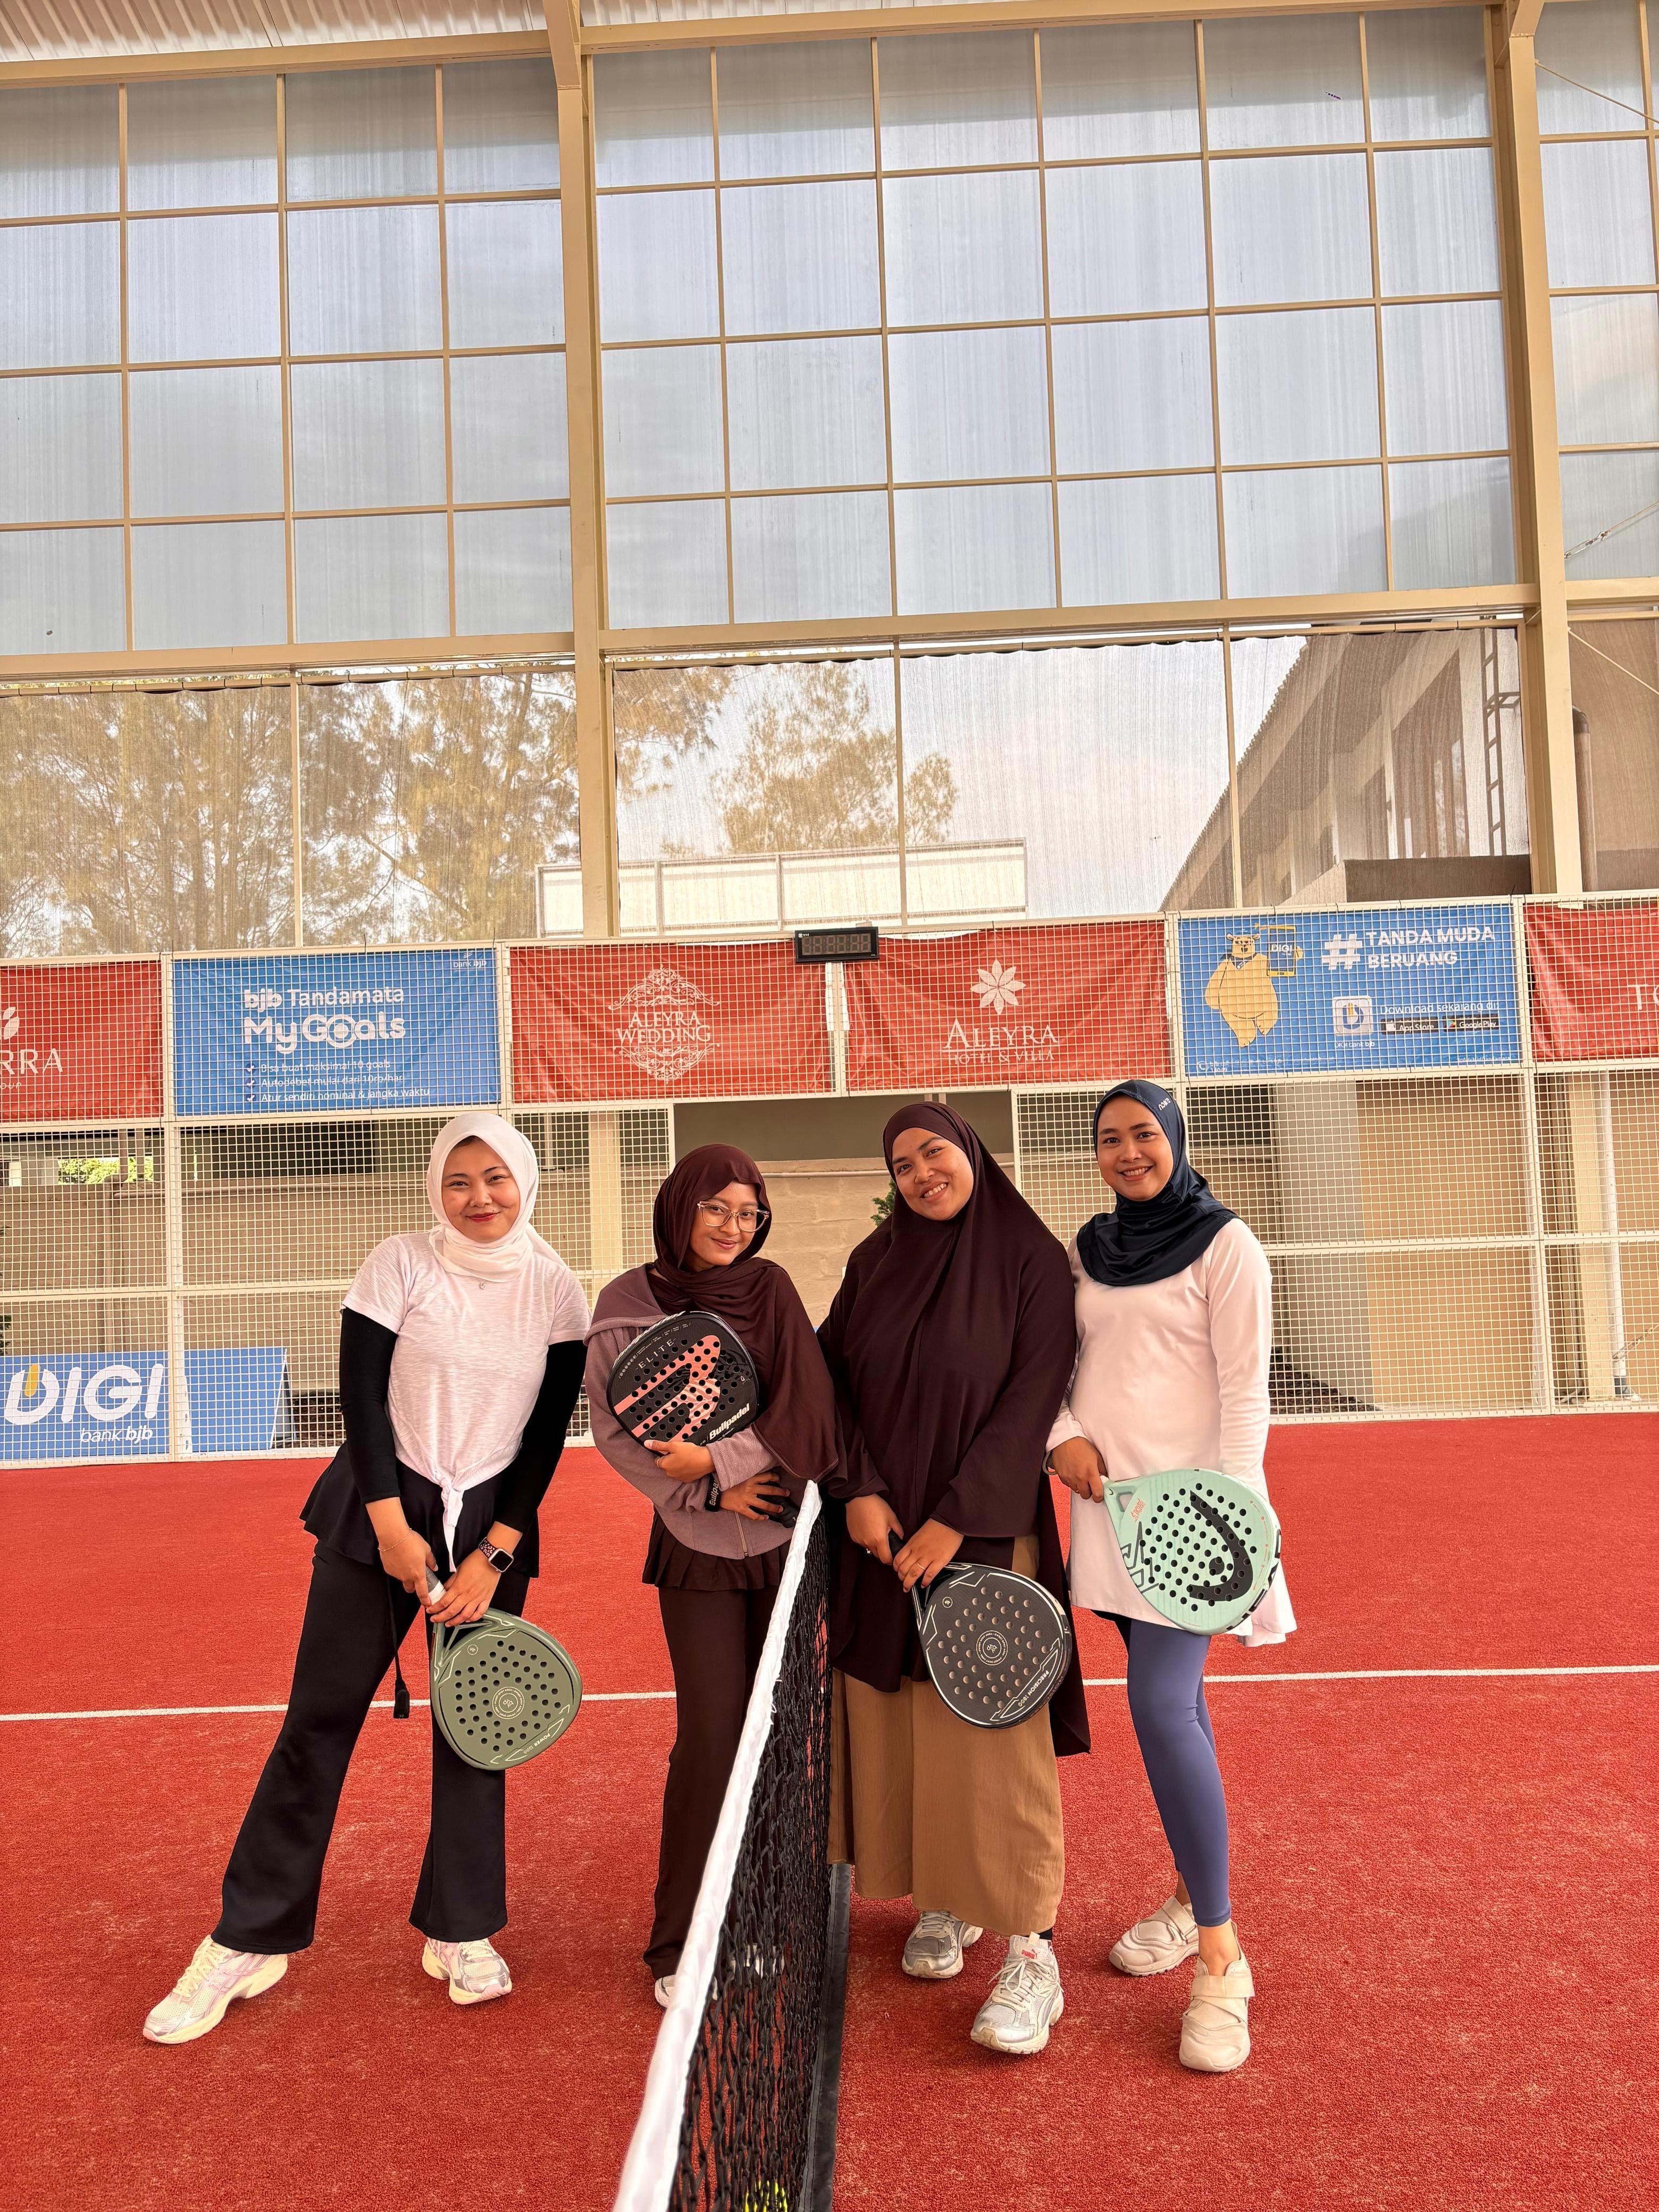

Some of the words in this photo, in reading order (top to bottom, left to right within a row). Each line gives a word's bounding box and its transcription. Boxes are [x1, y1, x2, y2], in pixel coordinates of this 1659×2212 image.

[1365, 929, 1433, 946] TANDA
[1437, 926, 1496, 943] MUDA
[1368, 951, 1458, 969] BERUANG
[244, 988, 282, 1012] bjb
[287, 986, 404, 1007] Tandamata
[1627, 984, 1659, 1010] T
[1380, 1003, 1434, 1014] Download
[1437, 1002, 1483, 1013] sekarang
[629, 1011, 702, 1028] ALEYRA
[616, 1025, 711, 1044] WEDDING
[942, 1018, 1059, 1049] ALEYRA
[1399, 1024, 1413, 1034] App
[261, 1063, 279, 1073] Bsa
[282, 1063, 303, 1071] buat
[306, 1061, 350, 1071] maksimal
[366, 1059, 391, 1071] goals
[948, 1053, 993, 1065] HOTEL
[999, 1050, 1010, 1063] &
[1015, 1050, 1055, 1061] VILLA
[261, 1077, 311, 1087] Autodebet
[314, 1076, 340, 1085] mulai
[342, 1075, 361, 1084] dari
[363, 1073, 405, 1084] 10rb/har
[261, 1094, 282, 1102] Atur
[284, 1092, 315, 1101] sendiri
[318, 1091, 356, 1101] nominal
[366, 1088, 399, 1100] jangka
[400, 1087, 431, 1097] waktu
[709, 1402, 750, 1440] Bullpadel
[80, 1427, 122, 1443] bank
[124, 1425, 154, 1444] bjb
[1027, 1670, 1050, 1696] PRECISION
[533, 1732, 551, 1747] POWER
